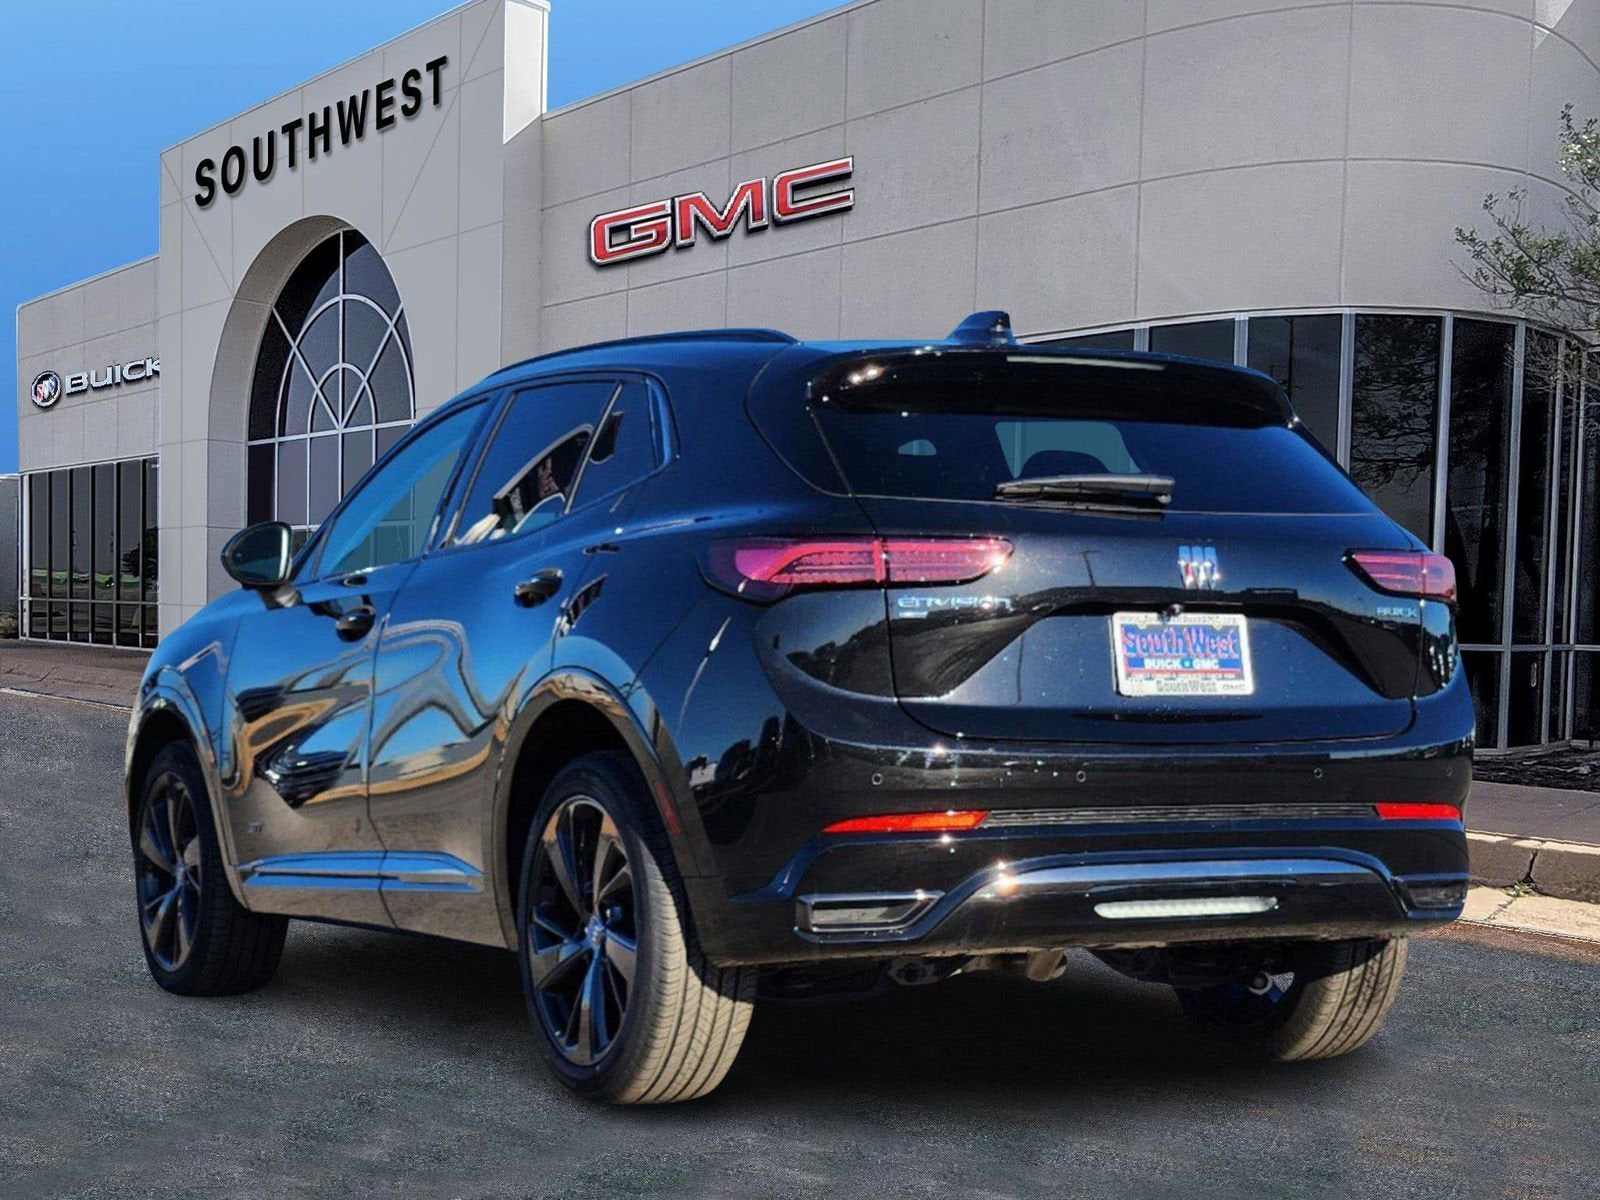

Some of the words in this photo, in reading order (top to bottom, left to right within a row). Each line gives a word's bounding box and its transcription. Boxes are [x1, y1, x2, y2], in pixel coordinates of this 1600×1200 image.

[194, 55, 448, 208] SOUTHWEST
[588, 155, 855, 268] GMC
[64, 357, 160, 396] BUICK
[1144, 658, 1182, 670] BUICK
[1192, 659, 1220, 670] GMC
